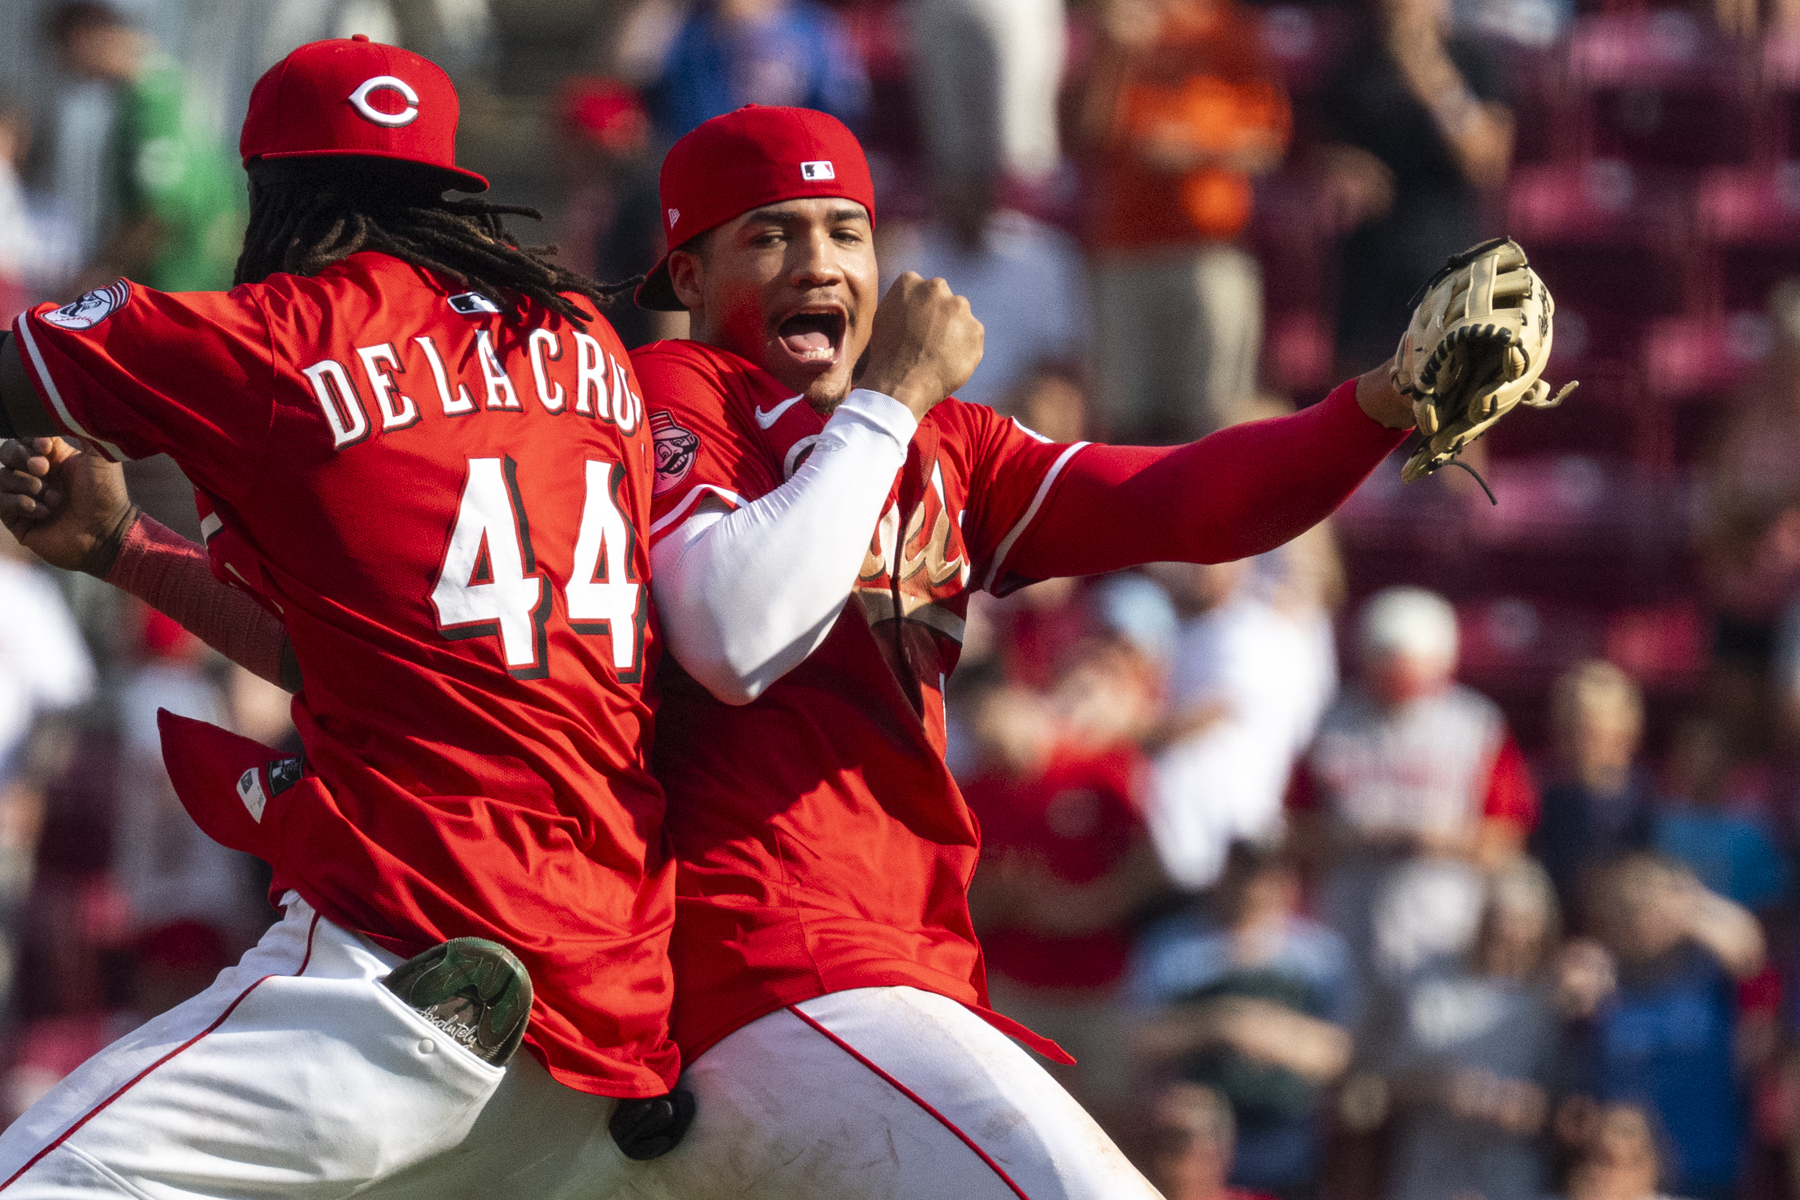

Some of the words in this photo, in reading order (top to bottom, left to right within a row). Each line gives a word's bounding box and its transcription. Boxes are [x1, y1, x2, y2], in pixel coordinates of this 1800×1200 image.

[347, 75, 419, 128] C
[303, 342, 422, 450] DE
[426, 454, 649, 683] 44
